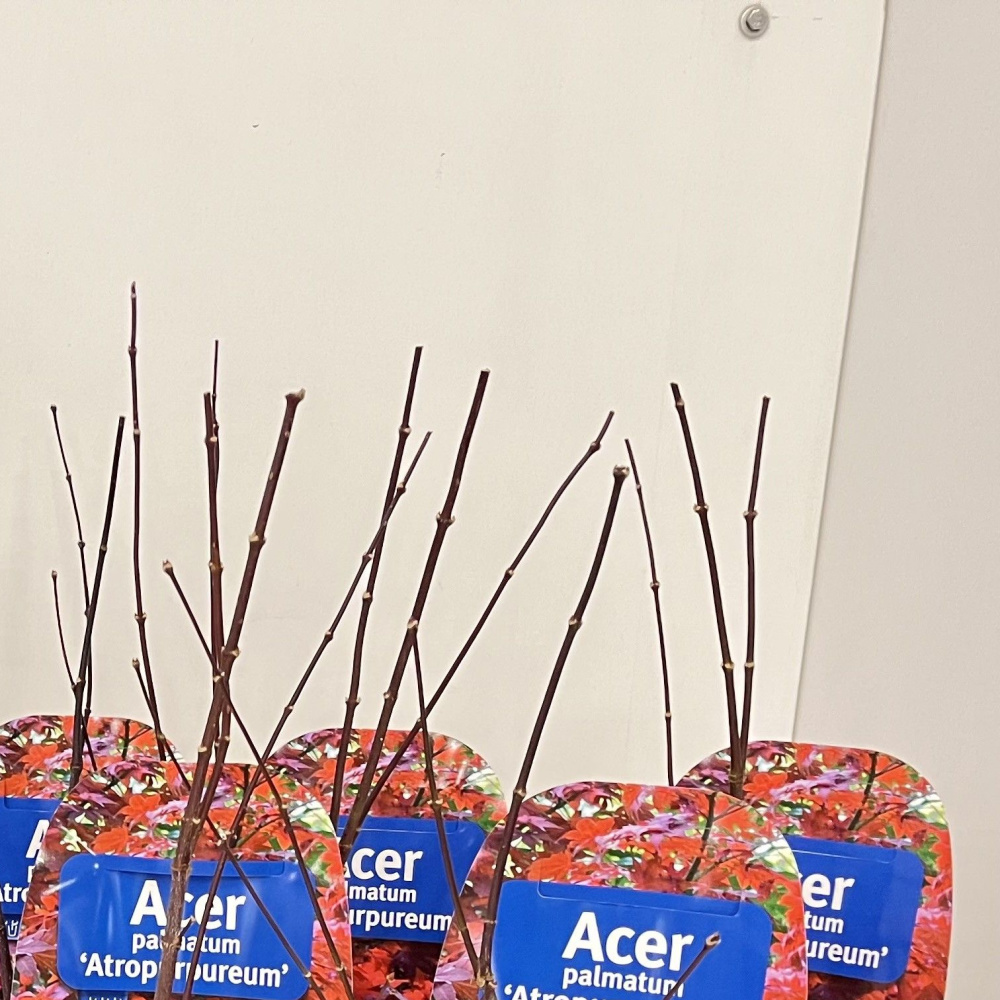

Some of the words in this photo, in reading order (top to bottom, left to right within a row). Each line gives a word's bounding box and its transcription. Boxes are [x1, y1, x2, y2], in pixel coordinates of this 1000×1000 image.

[799, 873, 856, 911] er
[131, 929, 241, 955] palatum
[562, 911, 695, 972] Acer
[79, 952, 290, 988] ‘Atroprpureum’
[562, 965, 685, 998] palmatum
